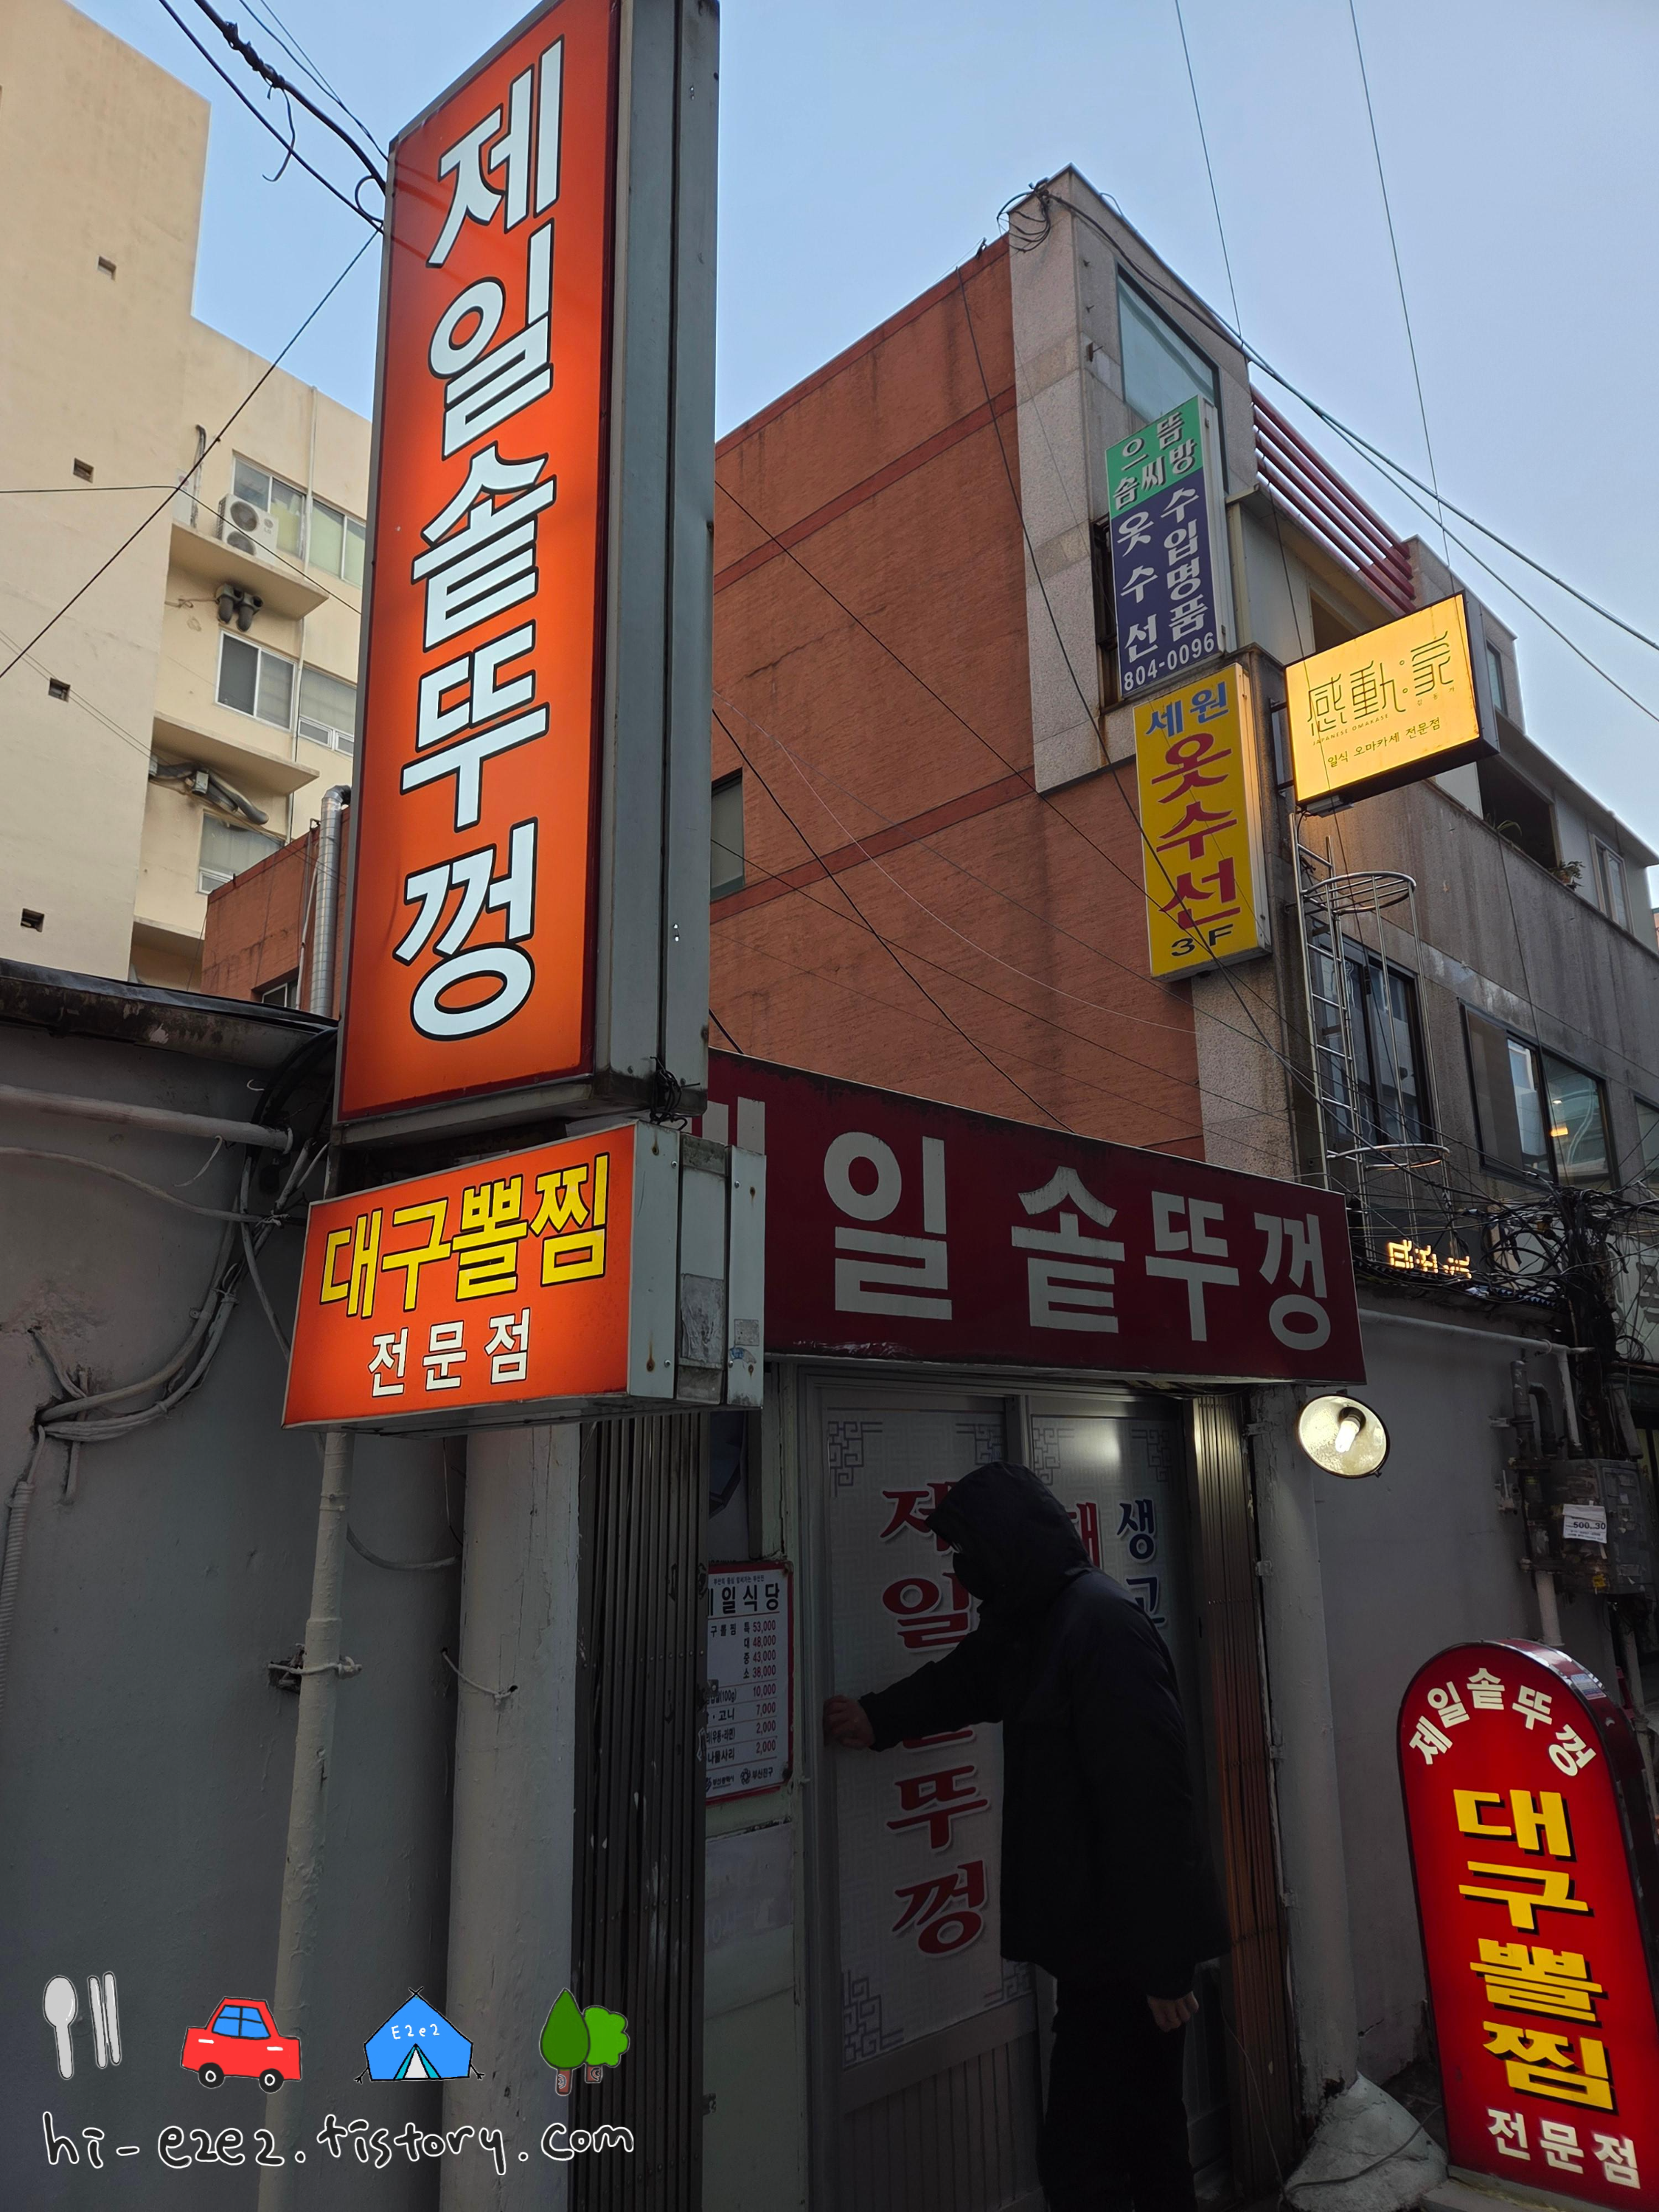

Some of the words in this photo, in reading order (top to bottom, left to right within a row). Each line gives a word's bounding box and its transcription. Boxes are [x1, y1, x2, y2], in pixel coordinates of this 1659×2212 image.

[1121, 411, 1185, 471] 으뜸
[1113, 438, 1197, 511] 솜씨방
[393, 35, 563, 1040] 제일솥뚜껑
[1161, 487, 1208, 641] 수입명품
[1117, 511, 1158, 663] 옷수선
[1124, 632, 1215, 691] 804-0096
[1146, 681, 1229, 737] 세원
[1312, 729, 1348, 746] JAPANESE
[1352, 714, 1388, 731] OMAKASE
[1328, 751, 1349, 768] 일식
[1354, 732, 1399, 757] 오마카세
[1405, 717, 1440, 740] 전문점
[1151, 733, 1240, 930] 옷수선
[320, 1152, 610, 1318] 대구뽈찜
[369, 1307, 530, 1397] 전문점
[744, 1637, 750, 1649] 대
[753, 1635, 776, 1649] 48,000
[753, 1620, 776, 1633] 53,000
[743, 1652, 750, 1664] 중
[753, 1649, 776, 1663] 43,000
[743, 1668, 750, 1679] 소
[753, 1664, 776, 1679] 38,000
[753, 1683, 776, 1697] 10,000
[757, 1702, 776, 1717] 7,000
[756, 1739, 776, 1756] 2,000
[757, 1720, 776, 1735] 2,000
[1409, 1667, 1596, 1776] 제일솥뚜껑
[1453, 1789, 1614, 2110] 대구뽈찜
[1487, 2107, 1641, 2189] 전문점
